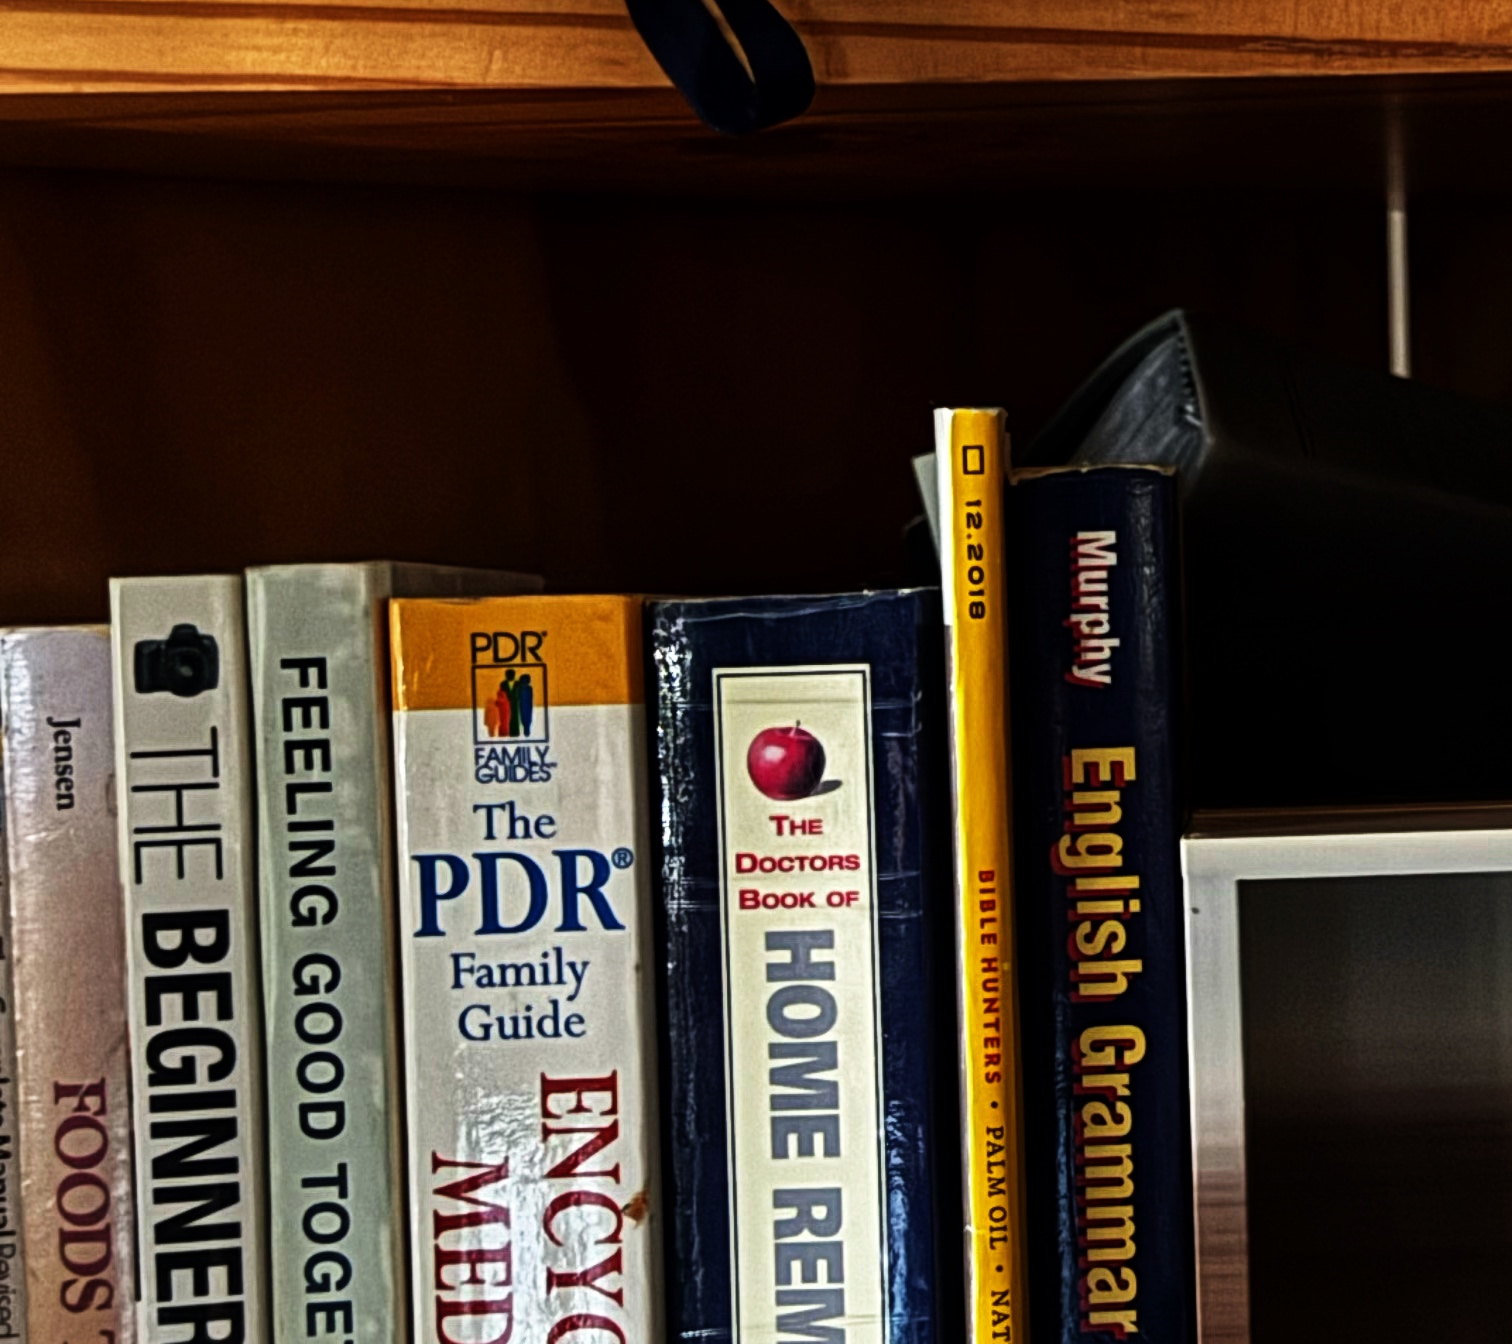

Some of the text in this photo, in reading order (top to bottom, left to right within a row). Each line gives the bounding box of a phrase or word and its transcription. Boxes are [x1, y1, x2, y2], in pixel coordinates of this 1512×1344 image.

[965, 499, 986, 621] 12.2018
[1066, 529, 1120, 686] Murphy
[46, 715, 82, 812] Jensen
[279, 655, 342, 929] FEELING
[474, 744, 550, 767] FAMILY
[474, 762, 553, 784] GUIDES
[129, 724, 224, 885] THE
[473, 801, 557, 841] The
[768, 814, 824, 837] THE
[735, 852, 861, 875] DOCTORS
[738, 888, 861, 911] BOOK OF
[1058, 745, 1146, 998] English
[977, 869, 998, 946] BIBLE
[449, 947, 590, 1002] Family
[293, 952, 348, 1141] GOOD
[458, 999, 588, 1042] Guide
[764, 929, 841, 1162] HOME
[979, 957, 1002, 1085] HUNTERS
[52, 1076, 116, 1314] FOODS
[984, 1124, 1007, 1198] PALM
[1076, 1023, 1149, 1336] Grammar
[986, 1205, 1009, 1251] OIL
